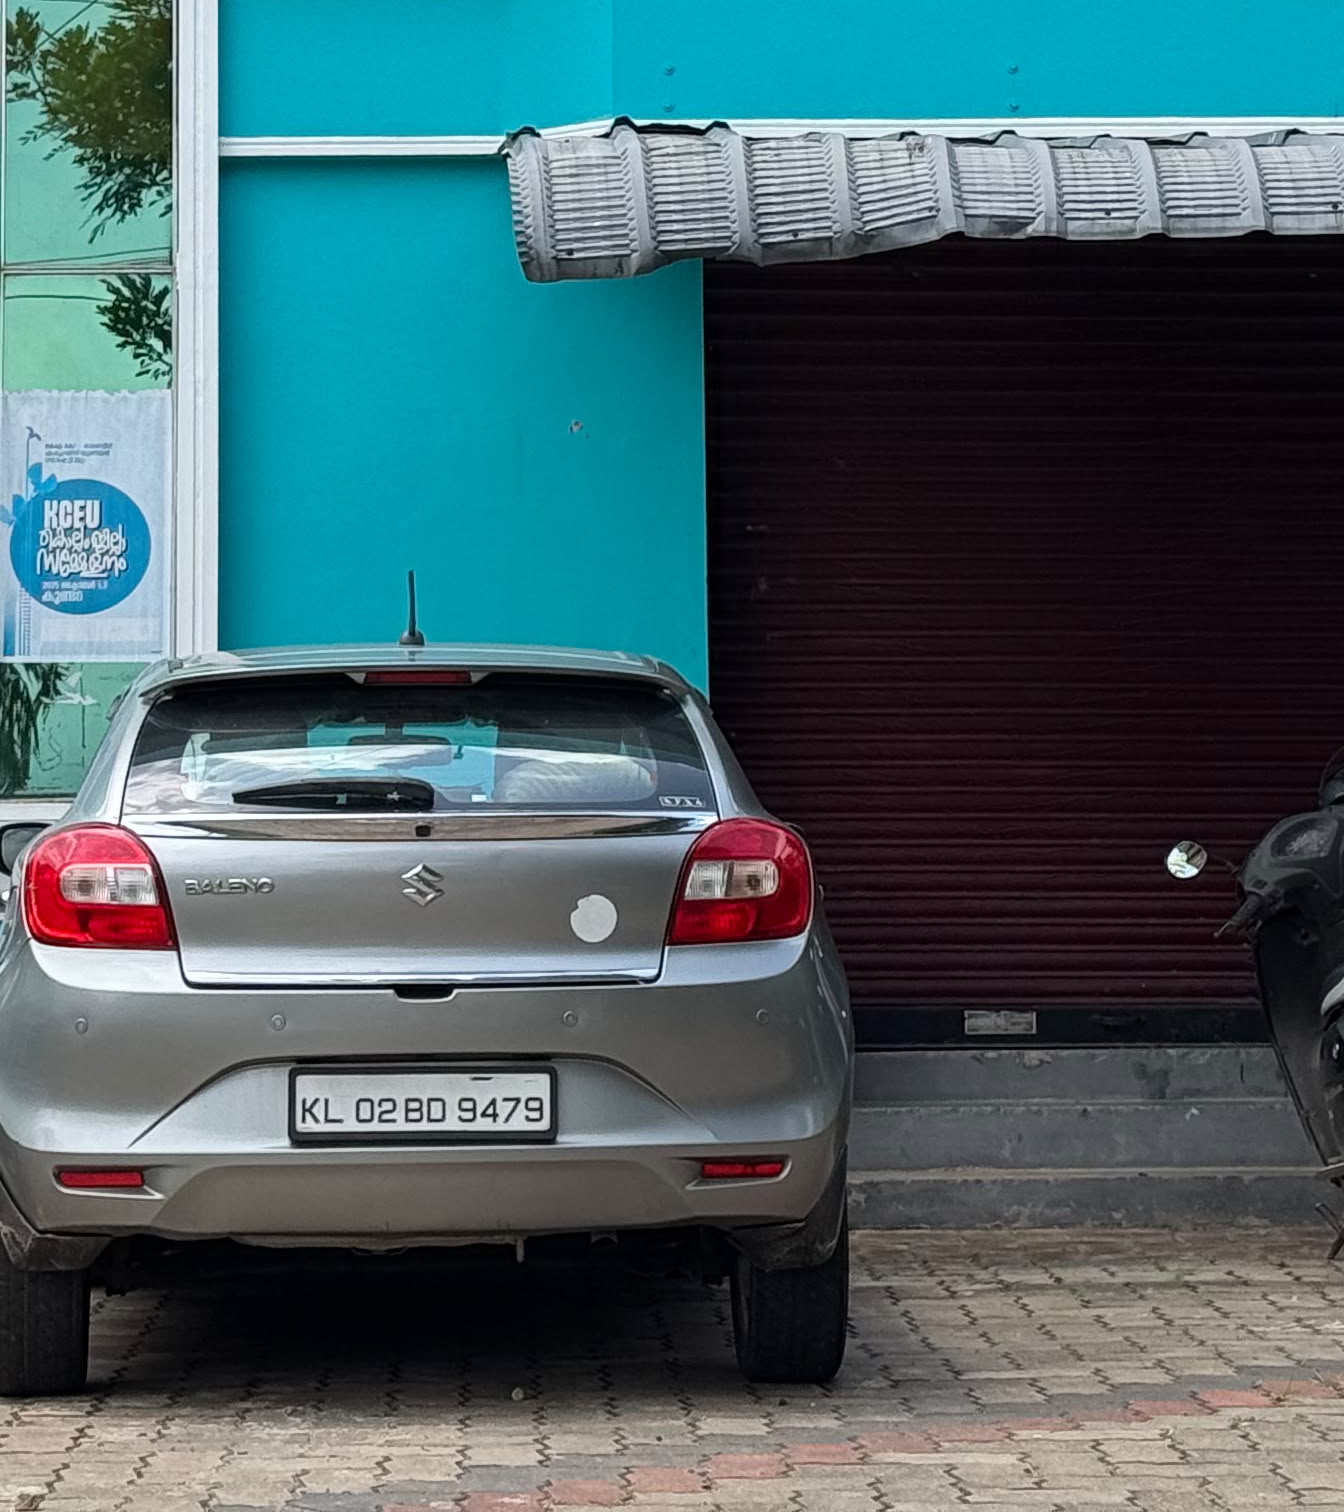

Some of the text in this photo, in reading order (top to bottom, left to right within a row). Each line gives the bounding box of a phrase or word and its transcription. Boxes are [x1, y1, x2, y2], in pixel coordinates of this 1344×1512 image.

[44, 499, 101, 529] KCEU
[184, 876, 276, 896] BALENO
[301, 1098, 344, 1124] KL
[457, 1096, 544, 1124] 9479
